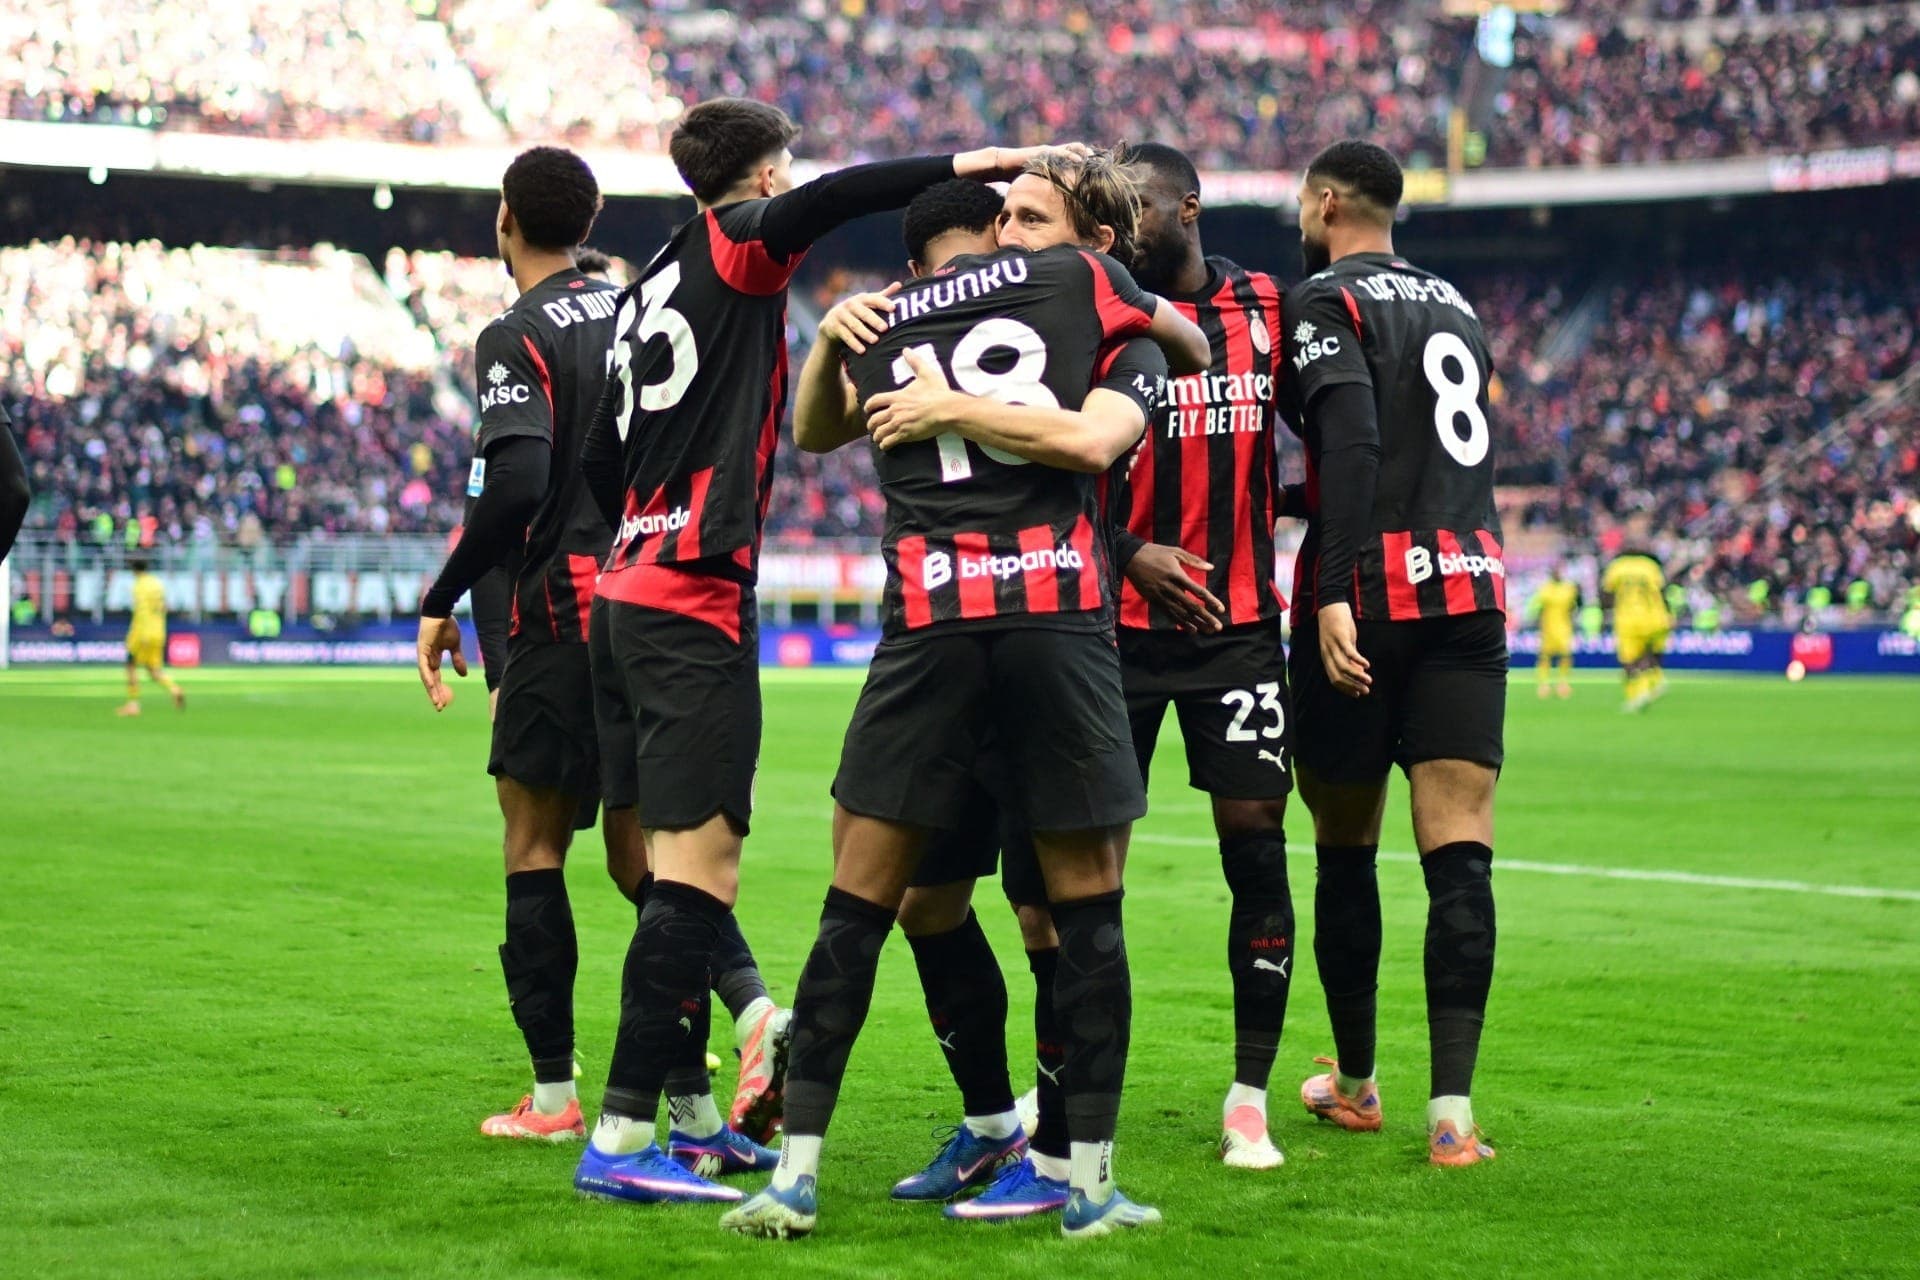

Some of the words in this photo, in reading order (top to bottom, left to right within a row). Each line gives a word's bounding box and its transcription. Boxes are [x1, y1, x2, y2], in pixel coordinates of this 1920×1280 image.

[888, 257, 1028, 328] NKUNKU
[542, 297, 585, 329] DE
[1292, 336, 1341, 376] MSC
[480, 384, 530, 413] MSC
[1157, 370, 1274, 407] mirates
[1422, 332, 1490, 467] 8
[1168, 410, 1200, 438] FLY
[1204, 405, 1263, 436] BETTER
[961, 543, 1084, 580] bitpanda
[1220, 681, 1285, 741] 23
